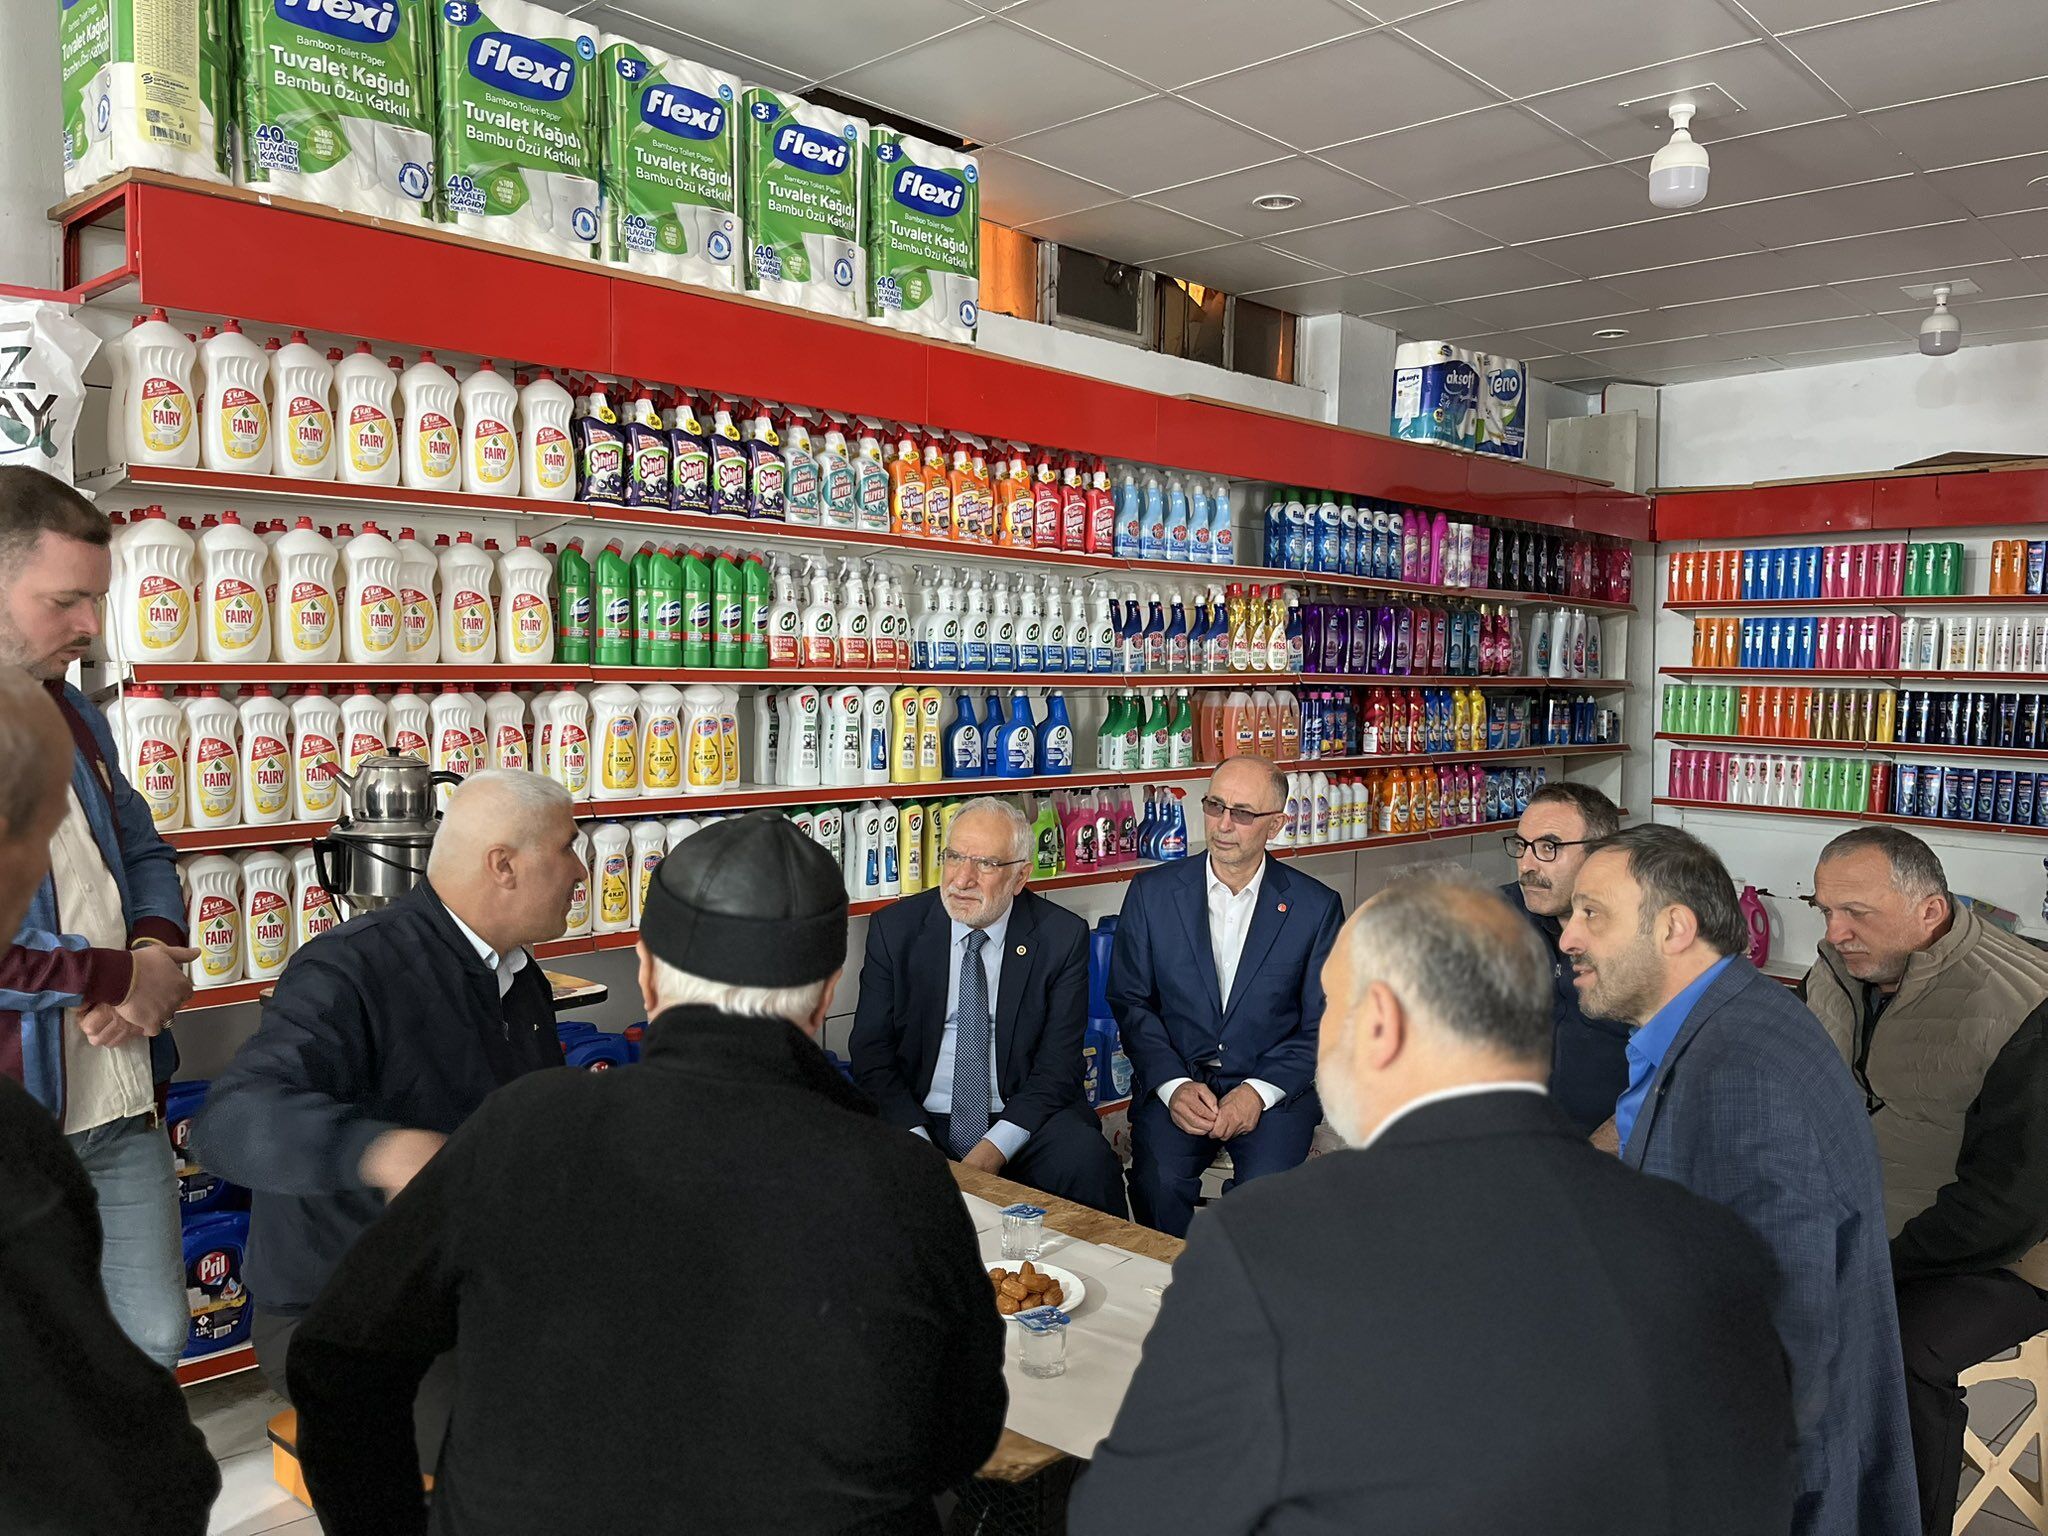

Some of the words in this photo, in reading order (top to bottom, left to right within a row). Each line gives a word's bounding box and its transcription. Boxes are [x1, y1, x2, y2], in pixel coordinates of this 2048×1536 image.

[284, 0, 394, 34] exi
[449, 3, 463, 22] 3
[296, 35, 335, 52] Bamboo
[336, 42, 360, 60] Toilet
[361, 52, 386, 68] Paper
[269, 44, 349, 80] Tuvalet
[352, 65, 410, 98] Kağıdı
[476, 37, 571, 92] Flexi
[621, 59, 633, 77] 3
[274, 70, 331, 95] Bambu
[334, 81, 363, 104] Özü
[366, 93, 410, 118] Katkılı
[485, 92, 518, 109] Bamboo
[517, 100, 541, 116] Toilet
[540, 108, 562, 123] Paper
[646, 88, 722, 133] Flexi
[756, 103, 766, 119] 3
[463, 100, 529, 135] Tuvalet
[533, 119, 581, 150] Kağıdı
[255, 124, 284, 143] 40
[258, 141, 298, 155] TUVALET
[466, 124, 513, 149] Bambu
[516, 136, 541, 157] Özü
[543, 144, 581, 168] Katkılı
[652, 139, 679, 154] Bamboo
[679, 146, 696, 158] Toilet
[696, 151, 714, 164] Paper
[779, 129, 847, 168] Flexi
[881, 144, 891, 160] 3
[634, 146, 688, 175] Tuvalet
[690, 162, 731, 187] Kağıdı
[447, 175, 473, 192] 40
[636, 166, 674, 187] Bambu
[675, 175, 696, 193] Özü
[698, 183, 732, 203] Katkılı
[784, 174, 809, 187] Bamboo
[809, 181, 825, 191] Toilet
[825, 185, 842, 195] Paper
[898, 170, 963, 209] Flexi
[450, 189, 486, 202] TUVALET
[767, 180, 818, 205] Tuvalet
[820, 194, 855, 217] Kağıdı
[623, 214, 647, 229] 40
[768, 200, 804, 218] Bambu
[806, 208, 825, 223] Özü
[827, 215, 855, 232] Katkılı
[905, 213, 927, 226] Bamboo
[926, 219, 940, 229] Toilet
[940, 223, 955, 234] Paper
[626, 227, 656, 239] TUVALET
[890, 219, 932, 245] Tuvalet
[935, 234, 968, 255] Kağıdı
[754, 245, 774, 260] 40
[891, 239, 923, 257] Bambu
[924, 247, 941, 261] Özü
[942, 253, 968, 270] Katkılı
[757, 257, 782, 271] TUVALET
[877, 277, 895, 290] 40
[1488, 370, 1518, 397] Teno
[153, 412, 182, 427] FAIRY
[232, 418, 259, 435] FAIRY
[299, 426, 324, 443] FAIRY
[359, 434, 385, 449] FAIRY
[429, 440, 451, 455] FAIRY
[483, 446, 507, 462] FAIRY
[544, 452, 566, 468] FAIRY
[1324, 539, 1331, 550] 4
[142, 580, 151, 592] 3
[150, 578, 165, 588] KAT
[219, 583, 226, 594] 3
[225, 581, 239, 590] KAT
[294, 586, 302, 597] 3
[300, 584, 314, 593] KAT
[149, 607, 179, 623] FAIRY
[225, 609, 253, 625] FAIRY
[301, 611, 326, 626] FAIRY
[370, 614, 394, 628] FAIRY
[404, 615, 426, 630] FAIRY
[781, 614, 796, 630] Cif
[816, 614, 832, 631] Cif
[462, 617, 484, 631] FAIRY
[520, 618, 542, 632] FAIRY
[852, 616, 866, 633] Cif
[881, 617, 895, 632] Cif
[945, 622, 957, 636] Cif
[806, 700, 816, 712] Cif
[849, 700, 859, 712] Cif
[874, 701, 884, 713] Cif
[906, 703, 916, 714] Cif
[927, 702, 938, 713] Cif
[653, 723, 675, 735] Bingo
[142, 747, 151, 759] 3
[150, 744, 165, 754] KAT
[201, 745, 208, 756] 3
[208, 743, 222, 752] KAT
[254, 743, 262, 754] 3
[261, 741, 275, 750] KAT
[502, 755, 523, 769] FAIRY
[564, 755, 585, 768] FAIRY
[619, 755, 632, 763] KAT
[659, 755, 673, 763] KAT
[703, 754, 716, 762] KAT
[447, 759, 470, 774] FAIRY
[145, 775, 175, 790] FAIRY
[204, 772, 231, 787] FAIRY
[257, 770, 284, 785] FAIRY
[868, 821, 878, 833] Cif
[885, 818, 896, 830] Cif
[911, 816, 921, 828] Cif
[1083, 827, 1093, 838] Cif
[613, 890, 625, 898] KAT
[202, 903, 210, 915] 3
[209, 900, 224, 910] KAT
[254, 898, 262, 910] 3
[261, 895, 275, 905] KAT
[205, 930, 234, 946] FAIRY
[257, 924, 284, 940] FAIRY
[200, 1254, 226, 1281] Pril
